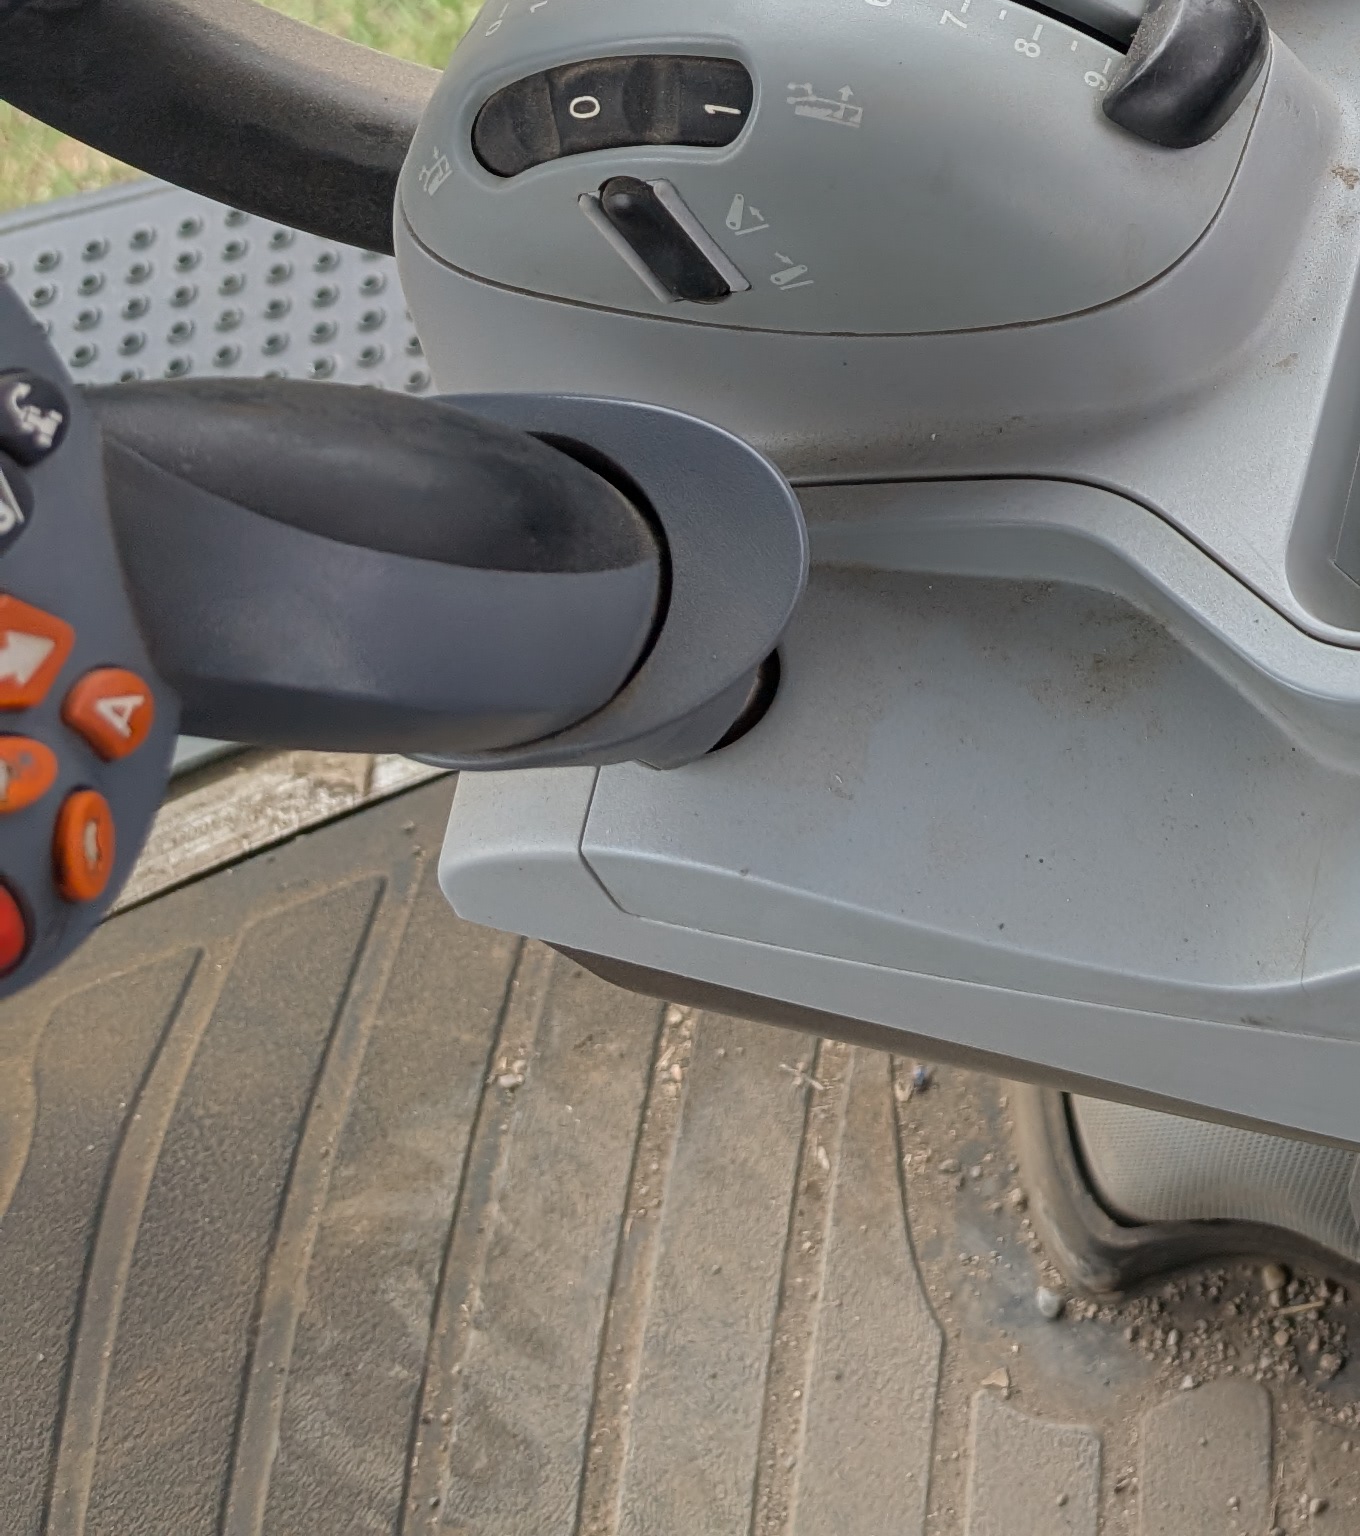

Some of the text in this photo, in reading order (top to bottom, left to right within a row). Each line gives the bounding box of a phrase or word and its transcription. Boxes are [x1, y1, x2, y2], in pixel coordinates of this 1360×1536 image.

[485, 19, 503, 37] 0
[529, 0, 548, 13] 1
[939, 9, 967, 29] 7
[1014, 38, 1041, 58] 8
[1083, 70, 1108, 91] 9
[569, 95, 601, 119] 0
[704, 104, 741, 115] 1
[95, 695, 146, 737] A
